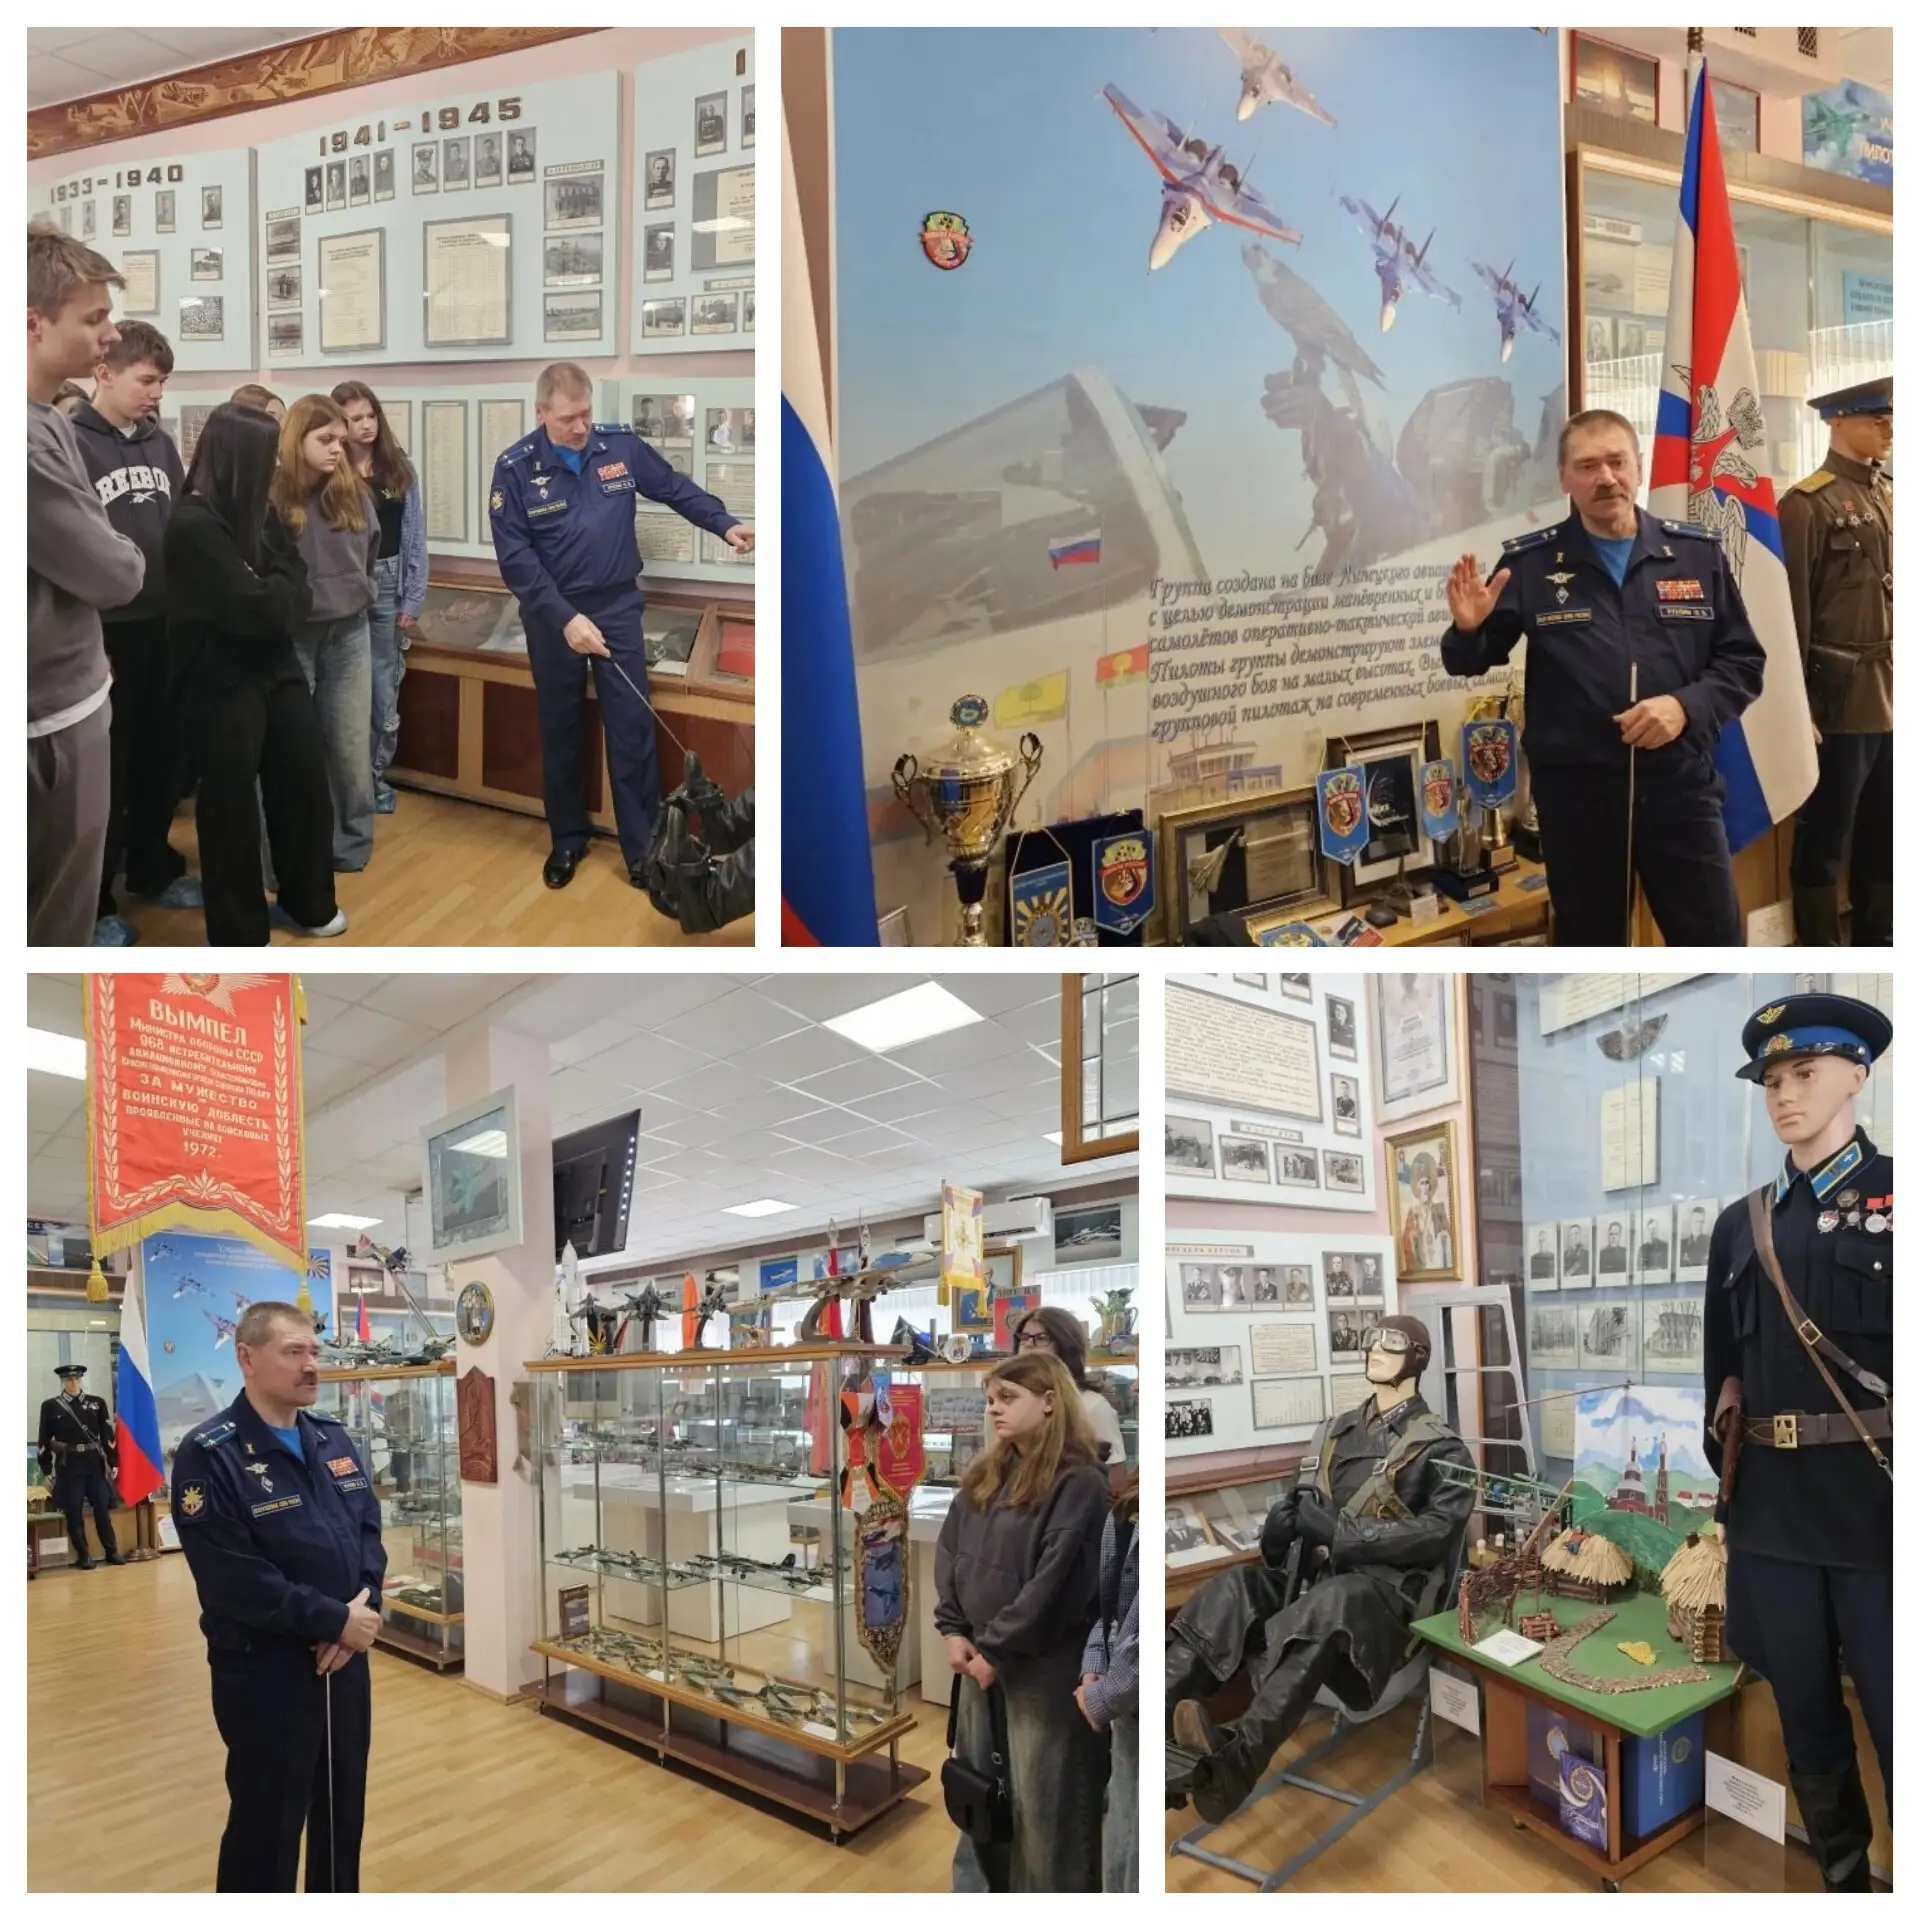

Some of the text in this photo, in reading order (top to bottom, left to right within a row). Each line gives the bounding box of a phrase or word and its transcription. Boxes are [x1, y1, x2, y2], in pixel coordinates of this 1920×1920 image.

[1150, 576, 1212, 605] Группа
[1216, 568, 1277, 594] создана
[1280, 574, 1298, 589] на
[1302, 565, 1333, 588] базе
[1148, 610, 1156, 627] с
[1162, 605, 1214, 630] целью
[1217, 597, 1330, 620] демонстрации
[1332, 586, 1425, 612] манёвренных
[1149, 627, 1239, 652] самолётов
[1150, 657, 1225, 683] Пилоты
[1229, 650, 1287, 679] группы
[1290, 637, 1405, 665] демонстрируют
[1152, 681, 1247, 713] воздушного
[1250, 671, 1278, 695] боя
[1282, 675, 1299, 691] на
[1303, 667, 1354, 689] малых
[1151, 705, 1237, 743] групповой
[1241, 697, 1316, 723] пилотаж
[1316, 693, 1333, 709] на
[1337, 681, 1427, 711] современных
[149, 997, 247, 1047] ВЫМПЕЛ
[235, 1047, 264, 1063] СССР
[122, 1088, 200, 1114] ВОИНСКУЮ
[140, 1072, 258, 1109] ЗА МУЖЕСТВО
[125, 1104, 201, 1128] ПРОЯВЛЕННЫЕ
[203, 1119, 215, 1131] НА
